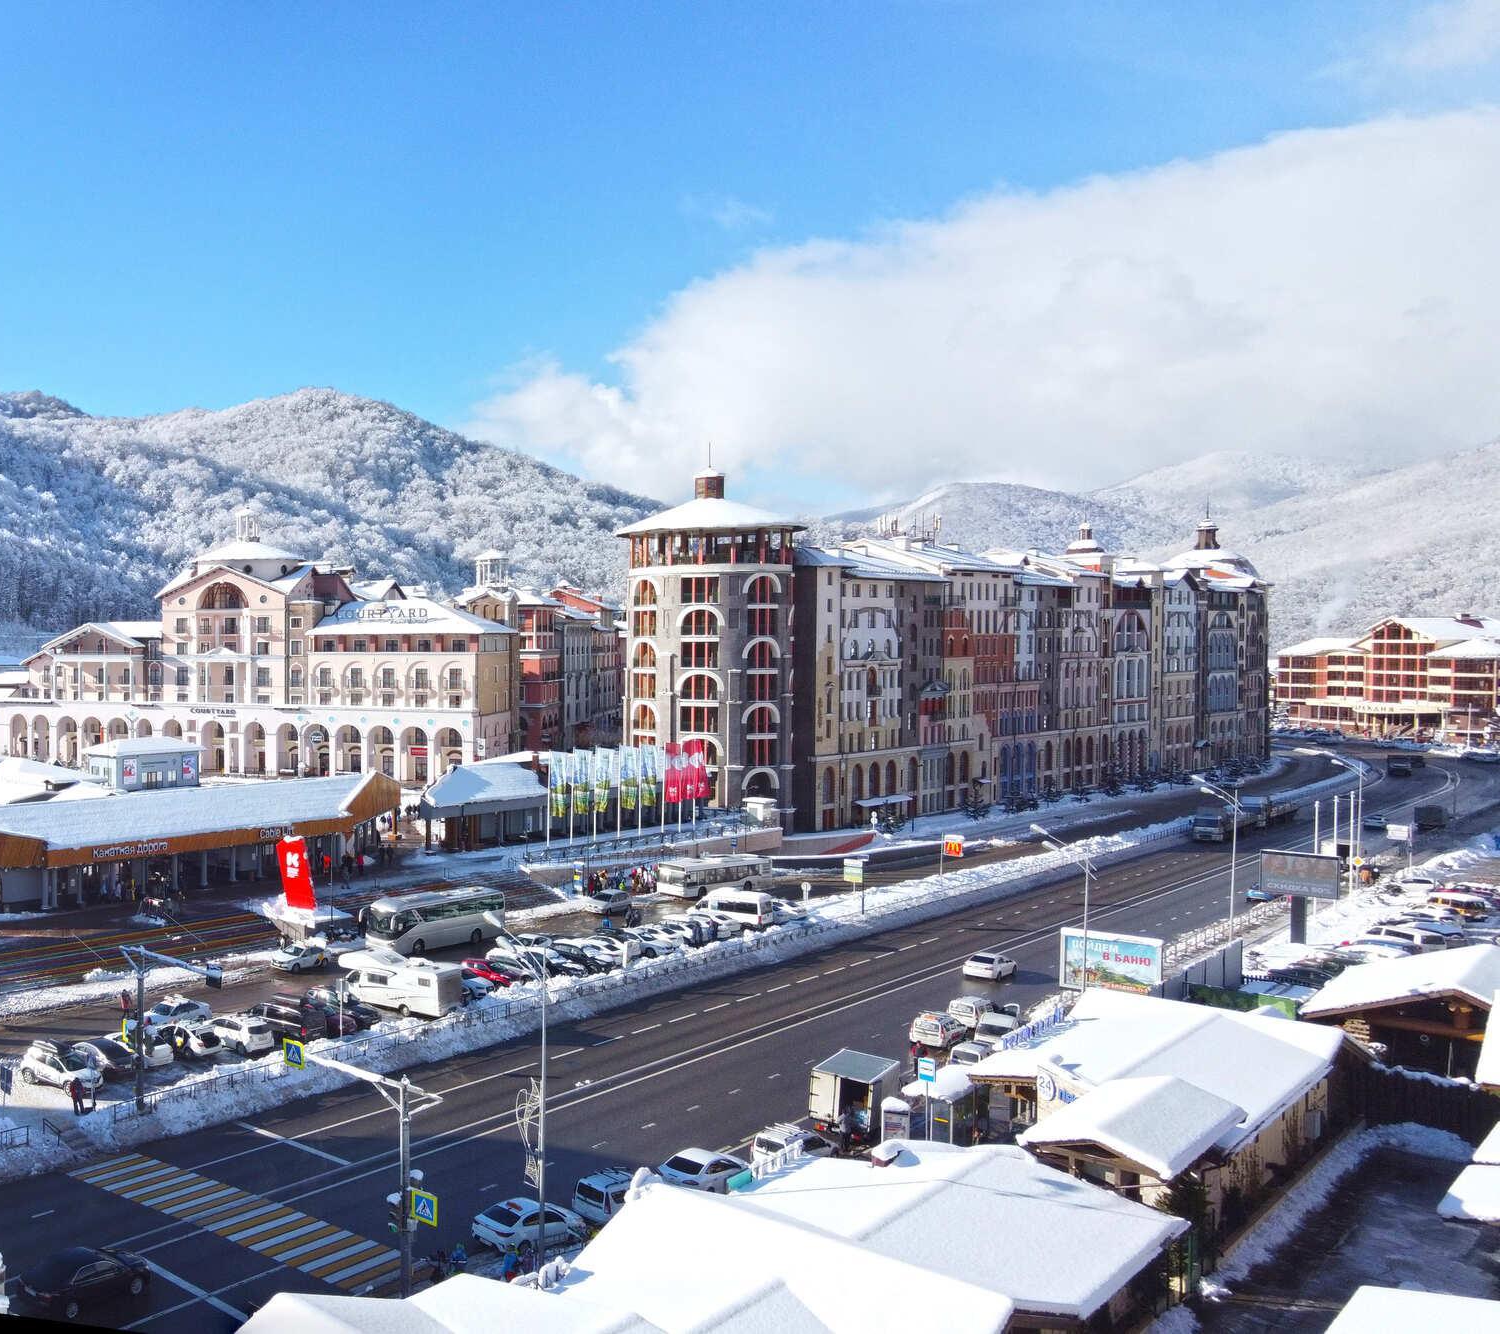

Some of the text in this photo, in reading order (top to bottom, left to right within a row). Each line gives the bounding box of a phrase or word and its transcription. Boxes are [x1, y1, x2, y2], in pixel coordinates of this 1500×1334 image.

[336, 607, 428, 619] COURTYARD
[1114, 953, 1151, 967] БАНЮ
[1038, 1075, 1051, 1091] 24
